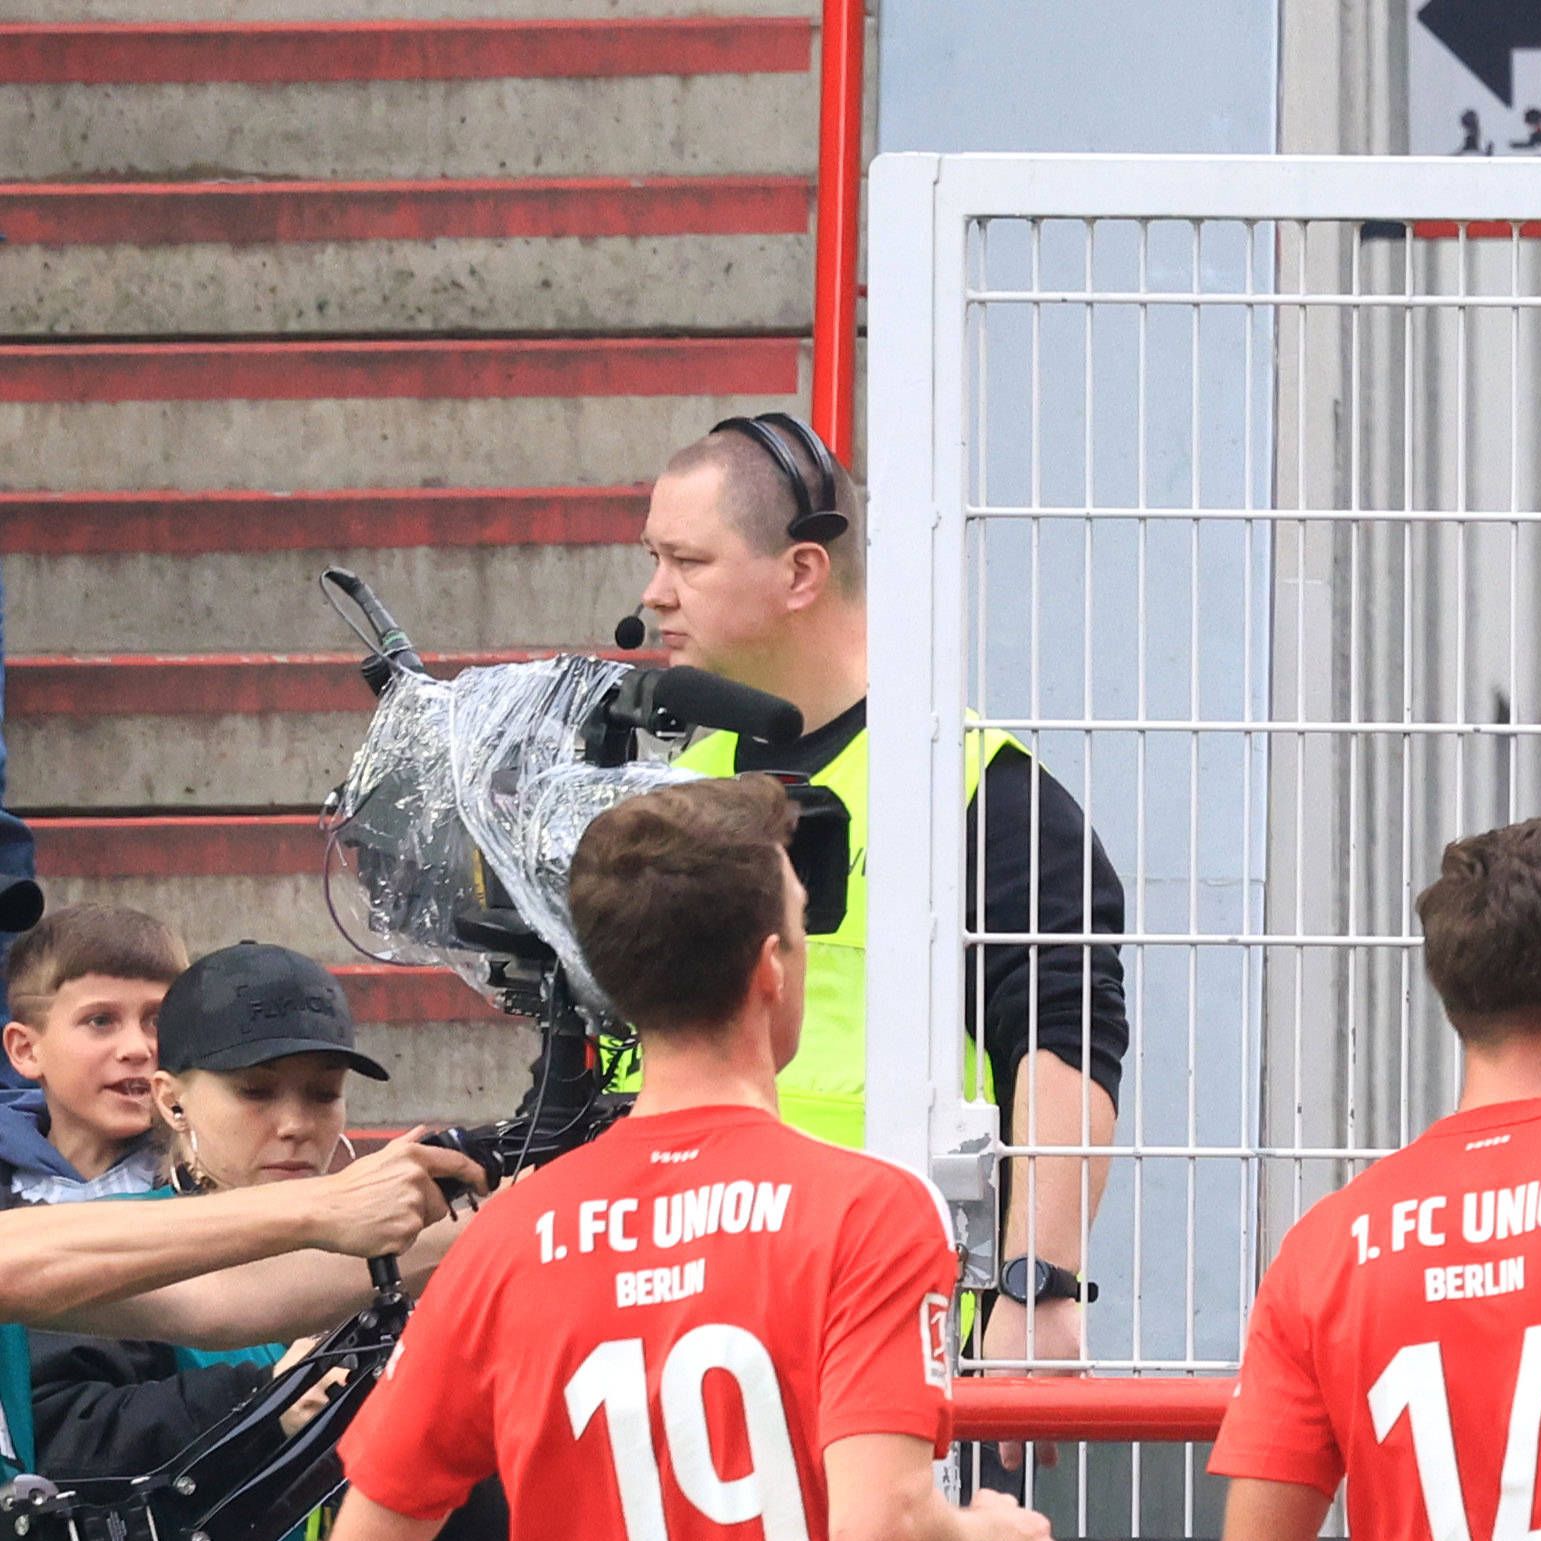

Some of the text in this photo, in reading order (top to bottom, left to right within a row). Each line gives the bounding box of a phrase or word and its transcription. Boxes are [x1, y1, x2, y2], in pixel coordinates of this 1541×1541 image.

[536, 1180, 792, 1264] 1. FC UNION
[1351, 1213, 1381, 1265] 1.
[1391, 1196, 1446, 1253] FC
[615, 1258, 706, 1308] BERLIN
[1424, 1256, 1526, 1303] BERLIN
